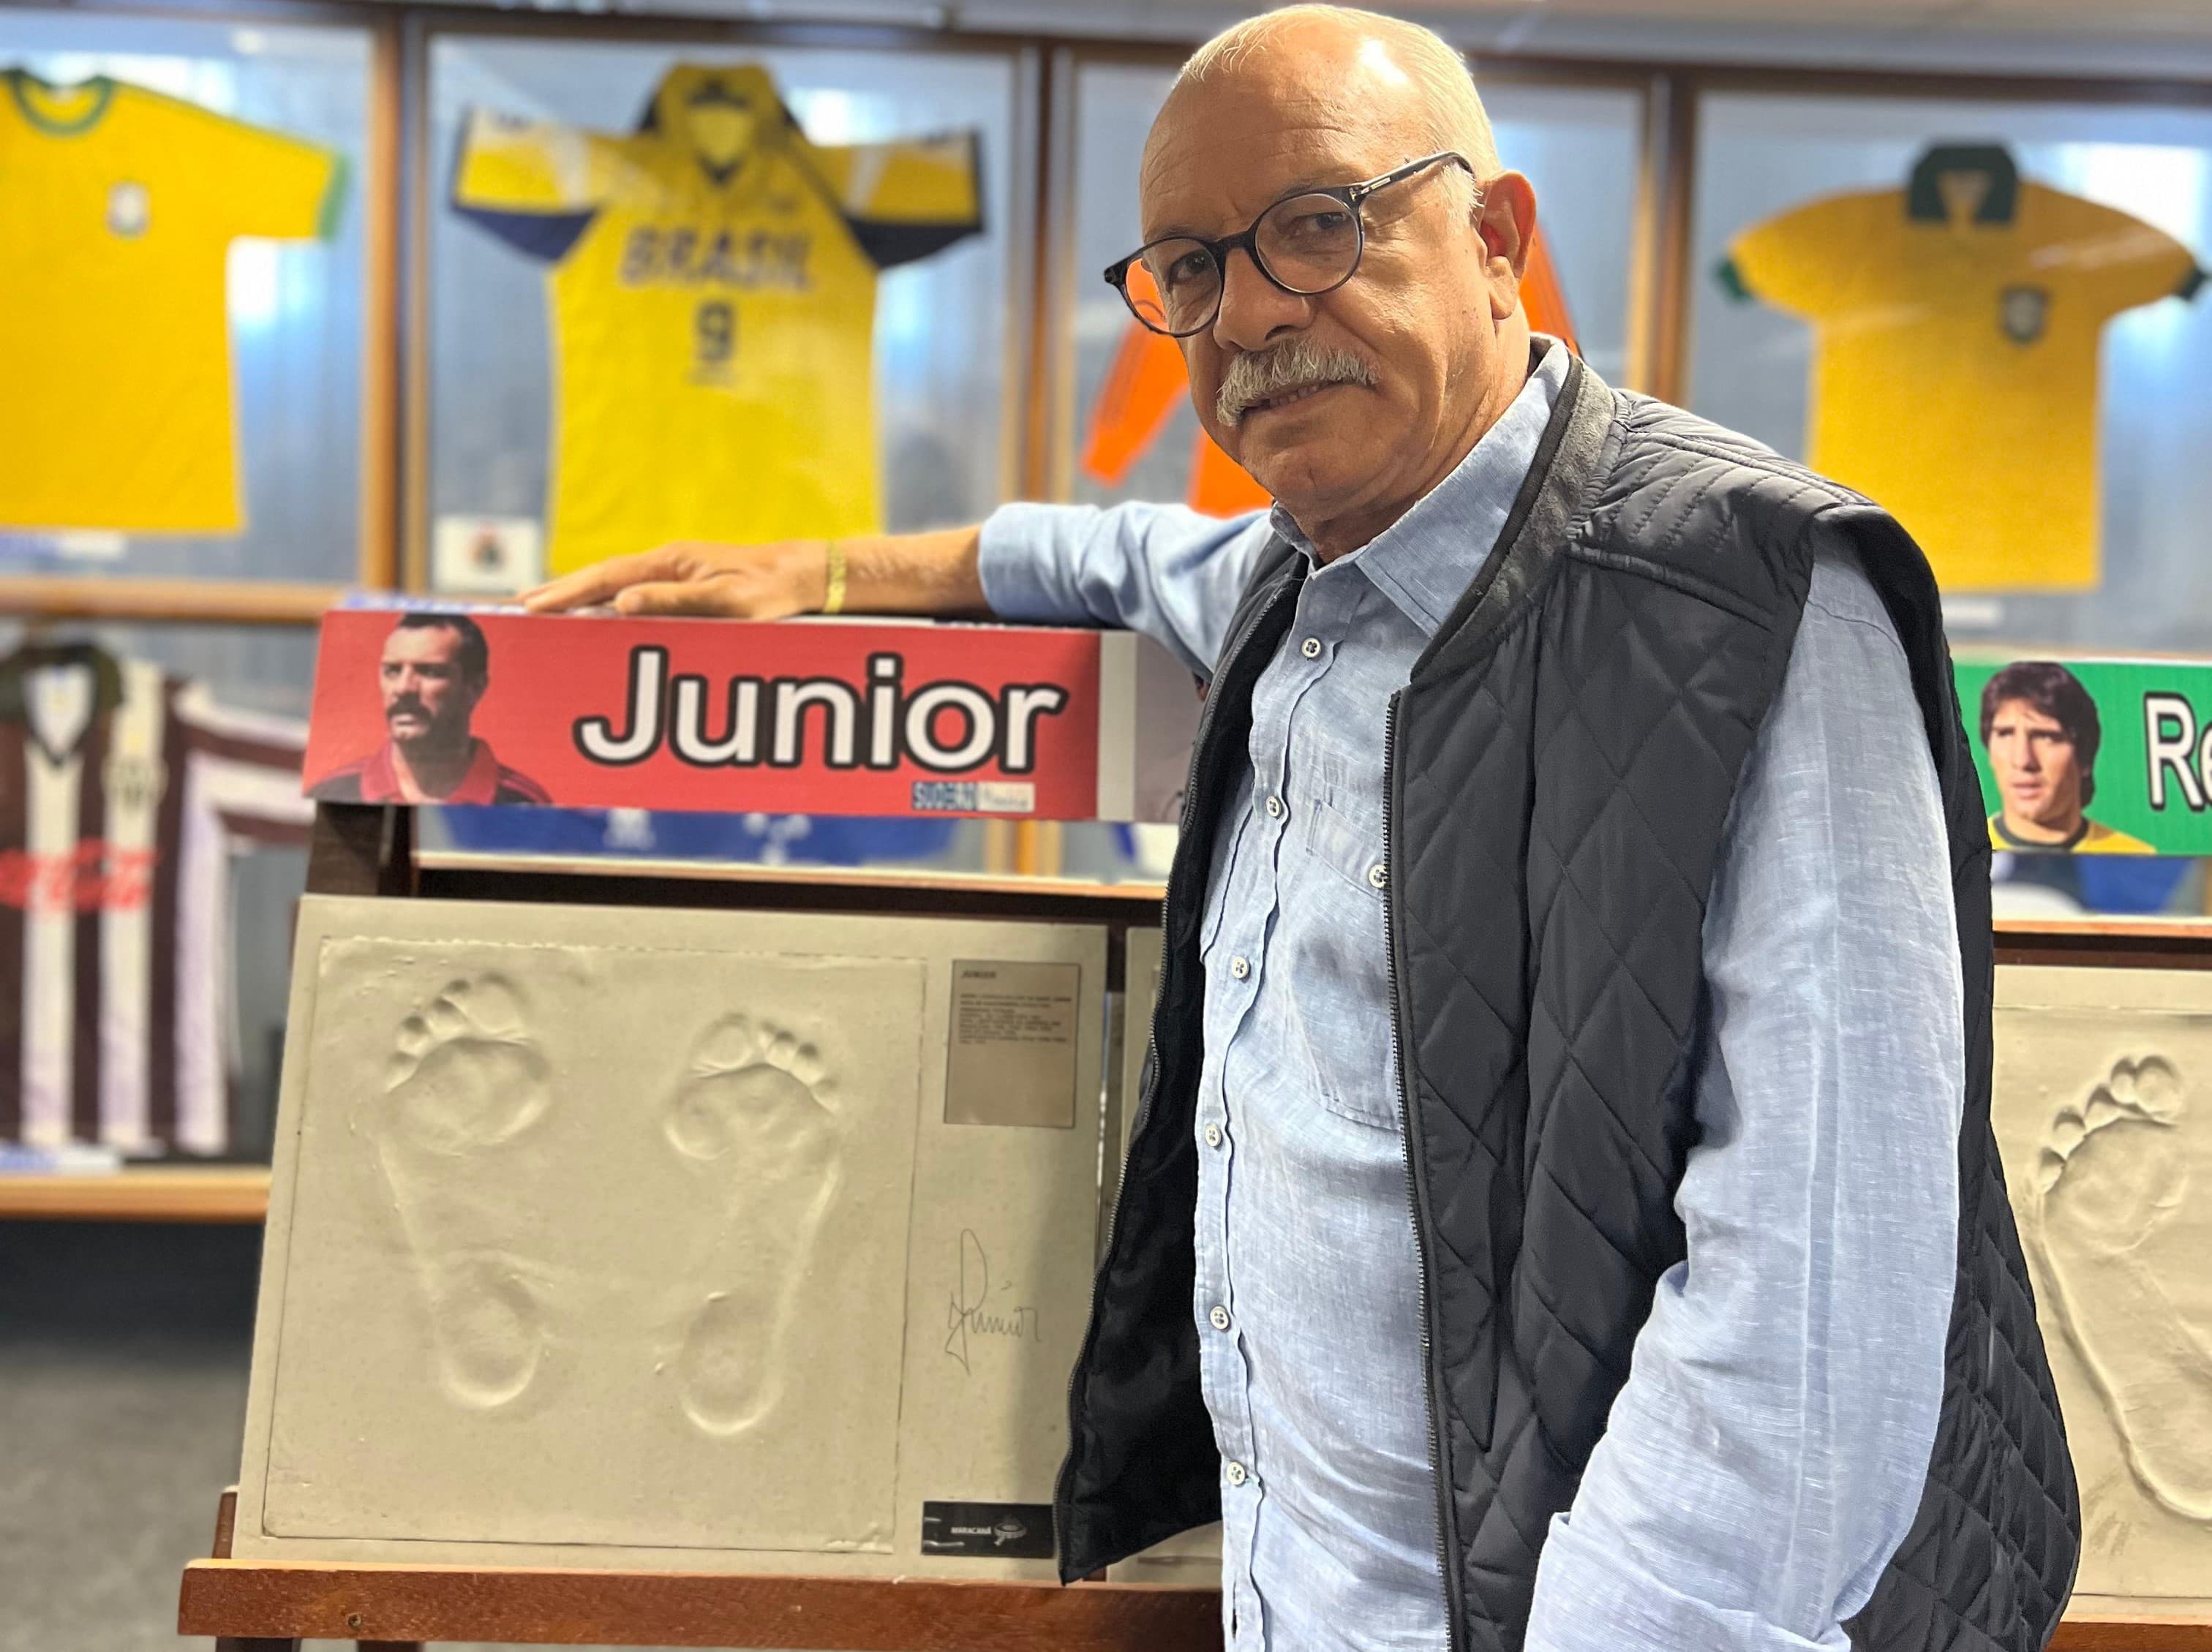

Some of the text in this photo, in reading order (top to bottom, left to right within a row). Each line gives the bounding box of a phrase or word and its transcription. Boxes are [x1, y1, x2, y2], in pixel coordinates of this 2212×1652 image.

[619, 225, 812, 291] BRASIL
[696, 301, 735, 363] 9
[574, 646, 1069, 774] Junior
